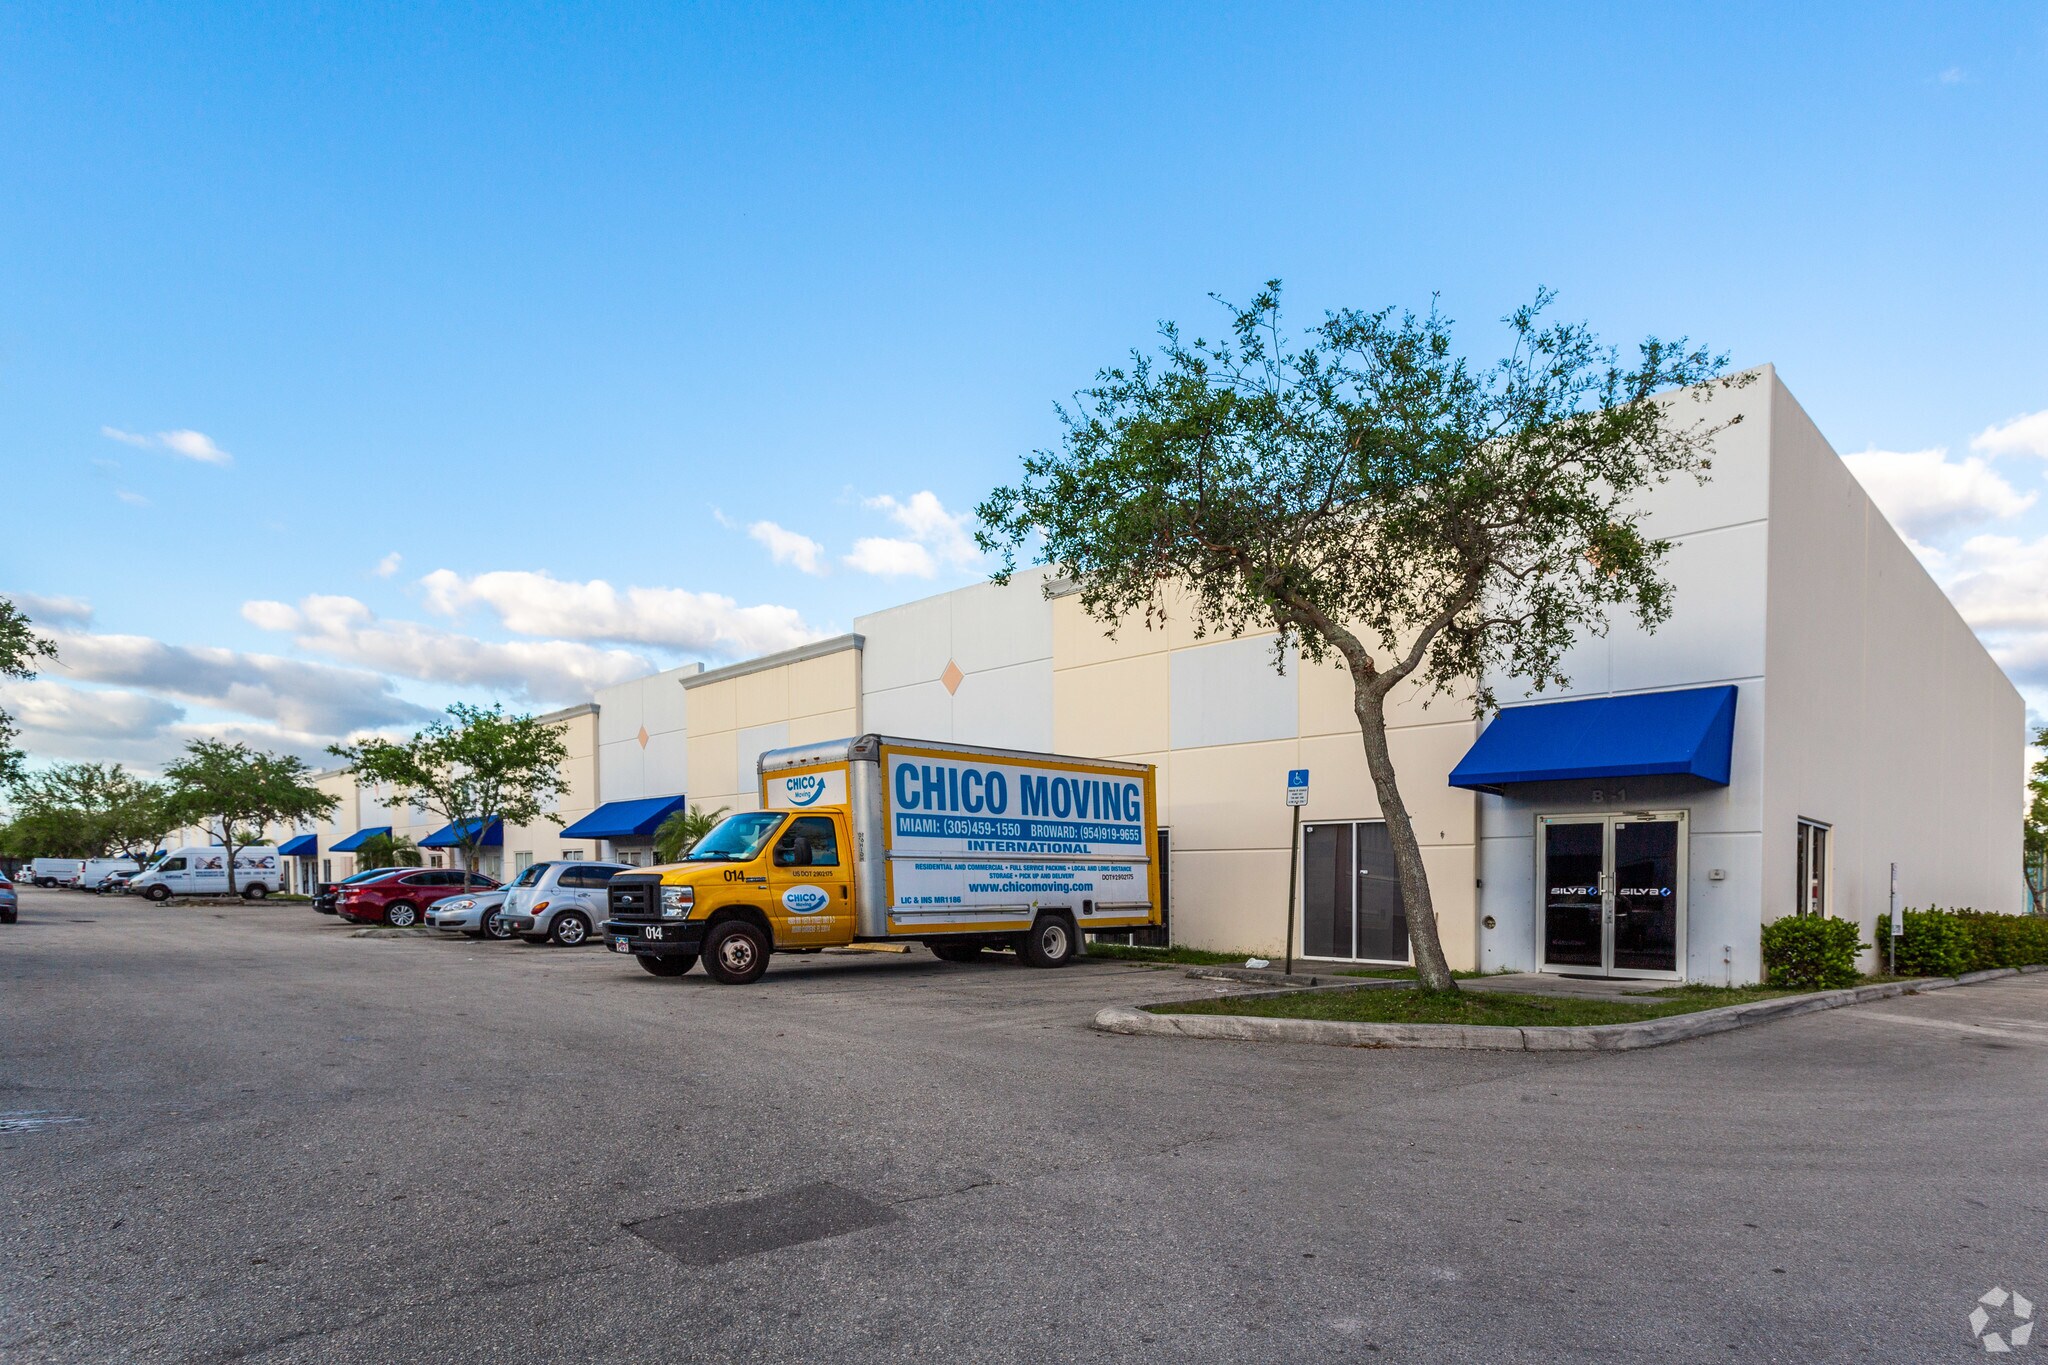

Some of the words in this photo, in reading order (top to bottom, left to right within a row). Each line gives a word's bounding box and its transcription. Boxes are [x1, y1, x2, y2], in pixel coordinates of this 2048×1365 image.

[786, 776, 815, 791] CHICO
[895, 763, 1007, 815] CHICO
[1020, 774, 1140, 822] MOVING
[900, 818, 940, 833] MIAMI:
[944, 818, 1020, 836] (305)459-1550
[1031, 824, 1078, 839] BROWARD:
[1080, 826, 1139, 841] (954)919-9655
[968, 840, 1091, 854] INTERNATIONAL
[915, 863, 953, 871] RESIDENTIAL
[723, 869, 746, 882] 014
[968, 881, 1093, 894] www.chicomoving.com
[786, 893, 816, 902] CHICO
[645, 926, 663, 940] 014
